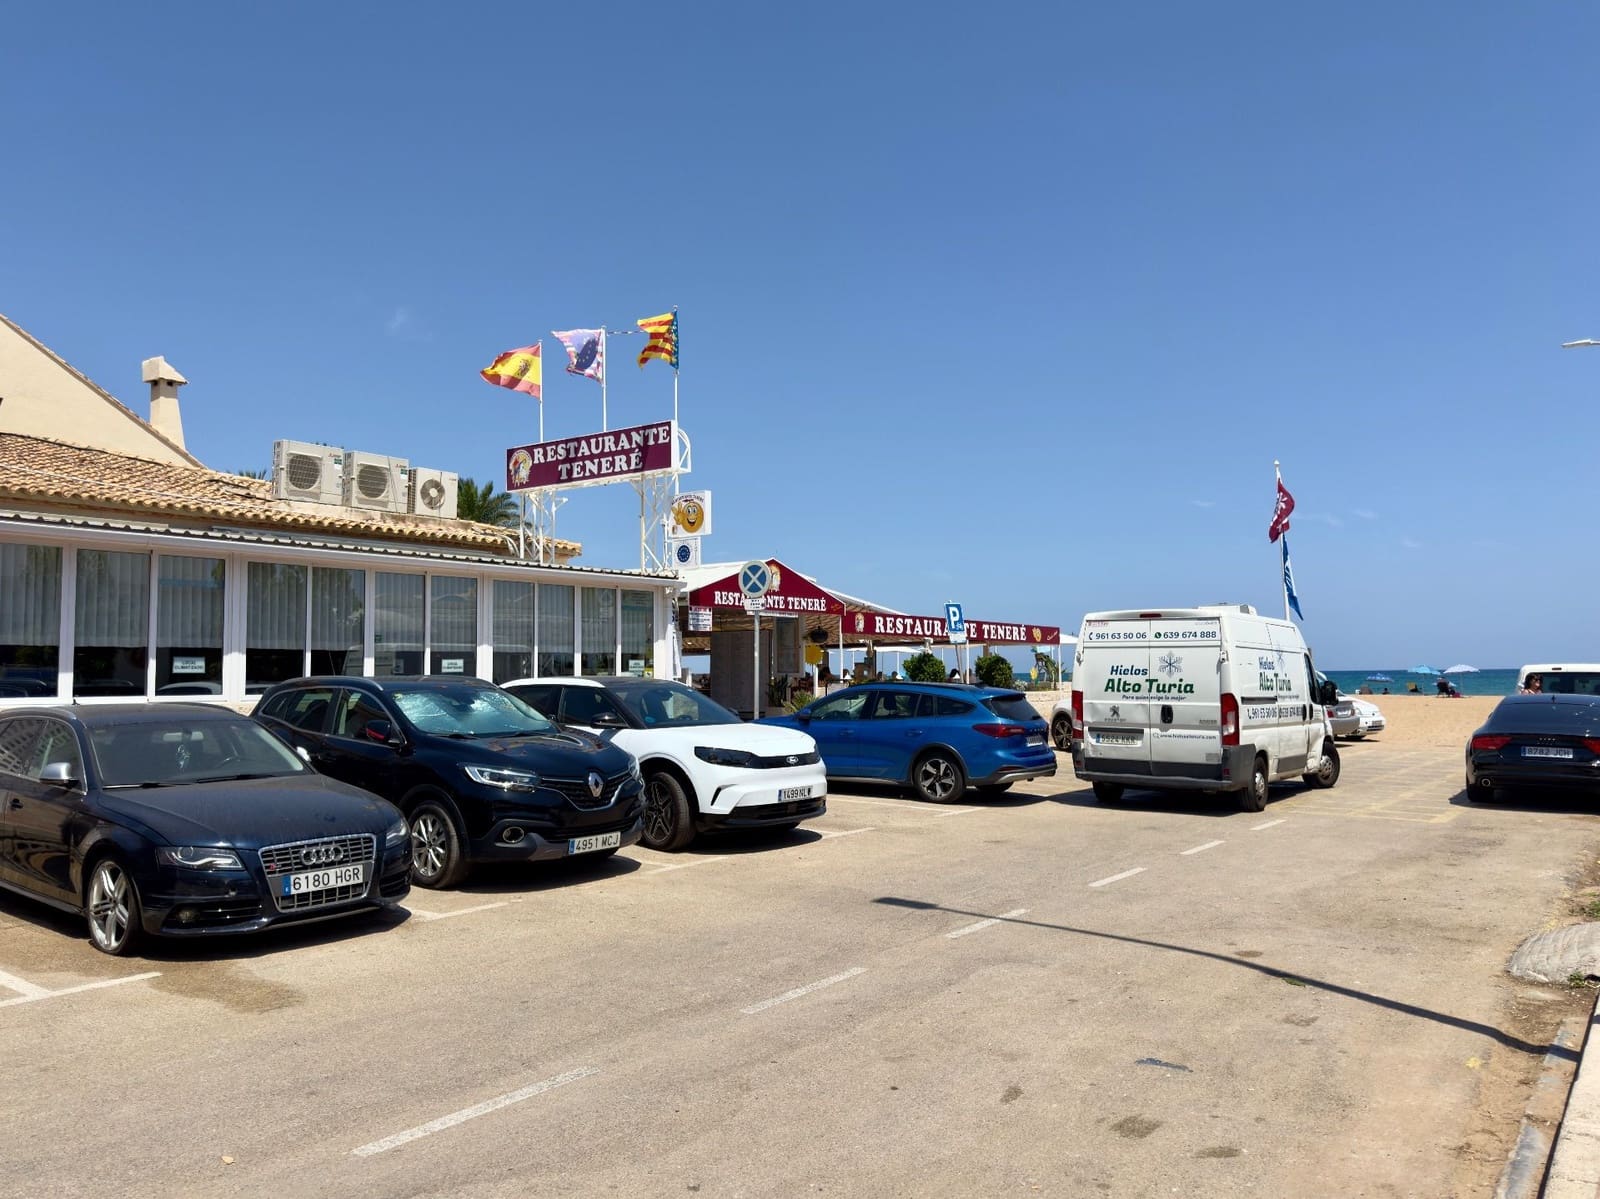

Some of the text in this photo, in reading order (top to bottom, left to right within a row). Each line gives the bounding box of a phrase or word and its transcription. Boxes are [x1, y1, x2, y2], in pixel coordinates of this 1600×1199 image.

[533, 425, 670, 464] RESTAURANTE
[558, 449, 643, 480] TENERÉ
[714, 591, 785, 609] RESTANTE
[787, 597, 827, 611] TENERÉ
[949, 606, 960, 629] P
[874, 616, 977, 638] RESTAURATE
[982, 624, 1027, 641] TENERÉ
[1095, 632, 1109, 640] 961
[1123, 632, 1134, 640] 50
[1136, 631, 1147, 640] 06
[1163, 630, 1217, 639] 639 674 888
[1110, 665, 1148, 676] Hielos
[1104, 678, 1194, 694] Alto Turia
[1259, 671, 1274, 691] Alto
[575, 838, 599, 851] 4951
[293, 867, 360, 890] 6180 HGR
